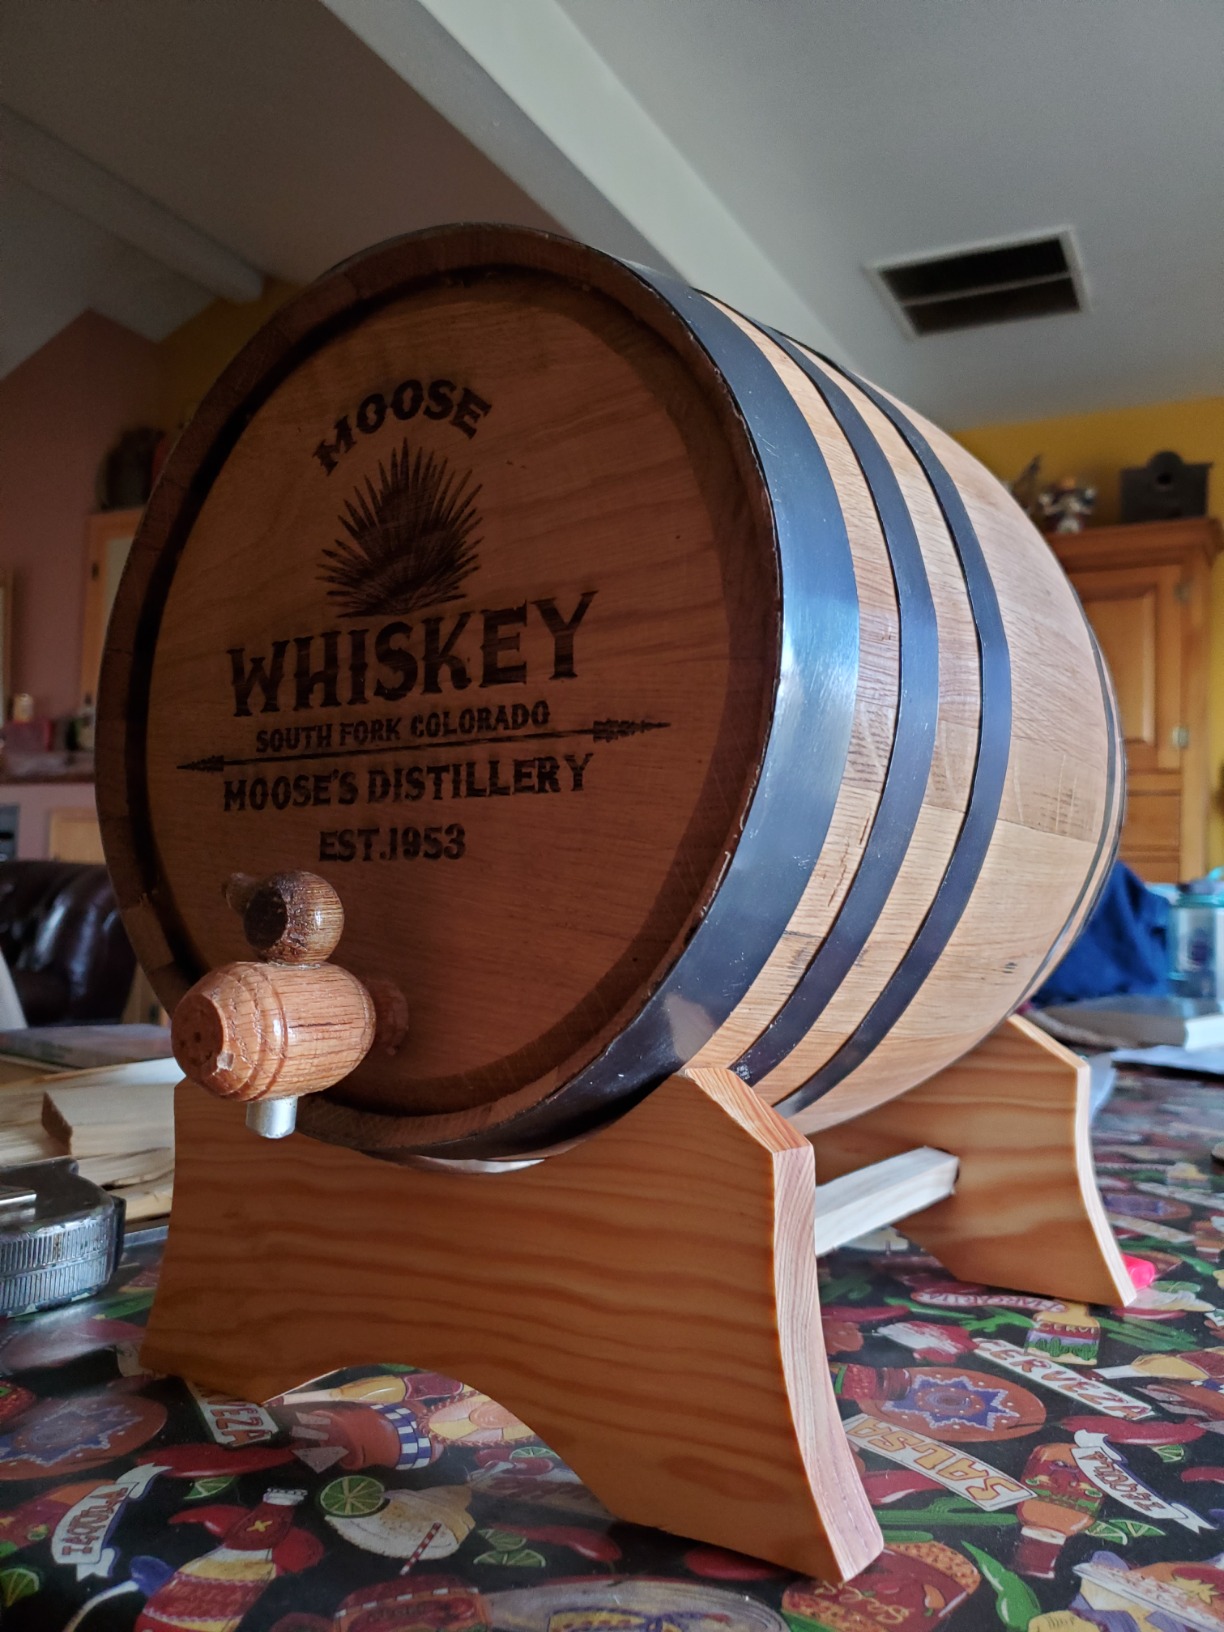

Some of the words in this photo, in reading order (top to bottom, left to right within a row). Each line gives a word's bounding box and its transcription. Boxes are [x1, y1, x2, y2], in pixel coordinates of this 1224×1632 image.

[312, 379, 492, 476] MOOSE
[226, 591, 598, 717] WHISKEY
[256, 722, 333, 753] SOUTH
[339, 716, 400, 747] FORK
[410, 700, 550, 739] COLORADO
[223, 768, 358, 812] MOOSE'S
[368, 753, 594, 804] DISTILLERY
[974, 1339, 1151, 1417] CERVEZA
[848, 1416, 1026, 1500] SALSA
[1080, 1449, 1167, 1511] TEQUILA
